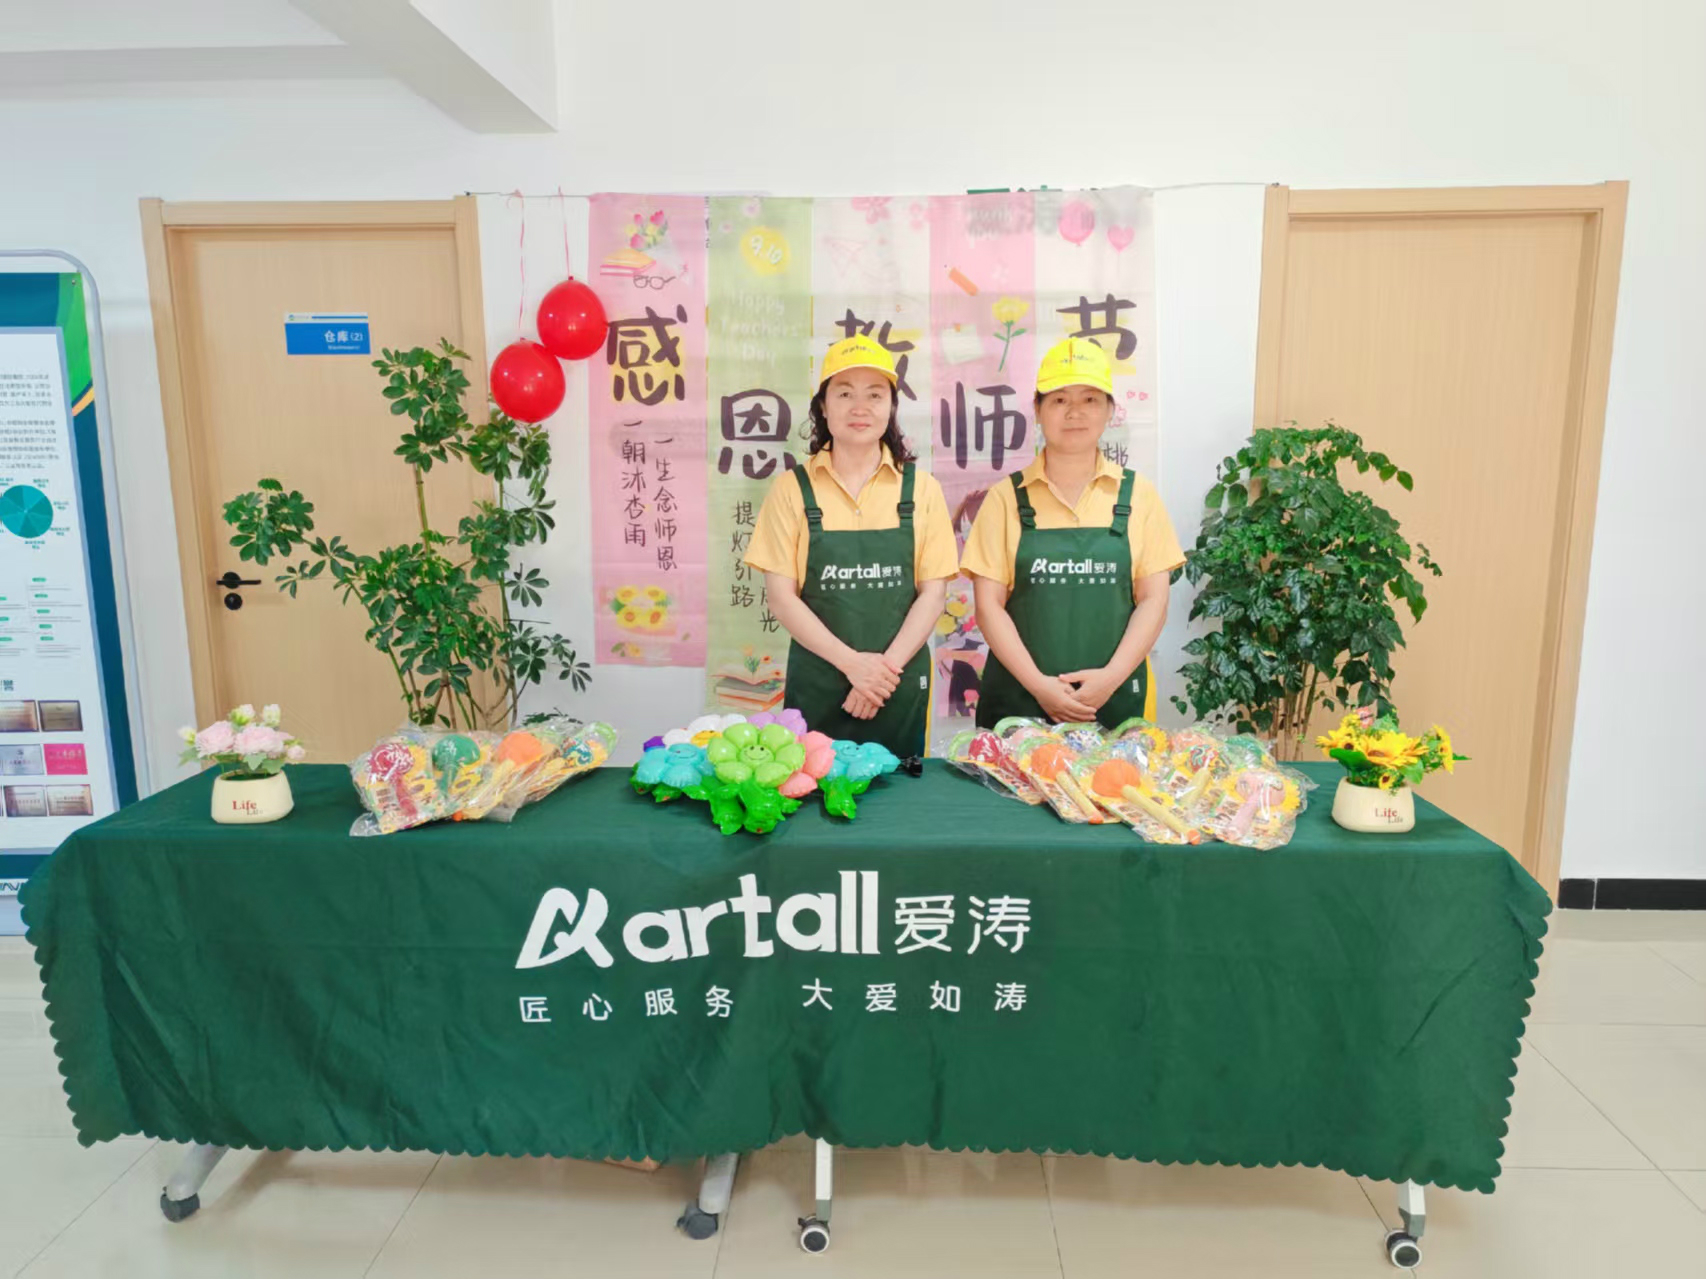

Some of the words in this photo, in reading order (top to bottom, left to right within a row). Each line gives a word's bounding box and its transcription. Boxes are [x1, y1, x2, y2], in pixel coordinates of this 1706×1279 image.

[607, 304, 688, 406] 感
[717, 388, 797, 480] 恩
[940, 381, 1027, 471] 师
[621, 420, 647, 548] 一朝沐杏雨
[653, 437, 678, 572] 一生念师恩
[232, 800, 257, 811] Life
